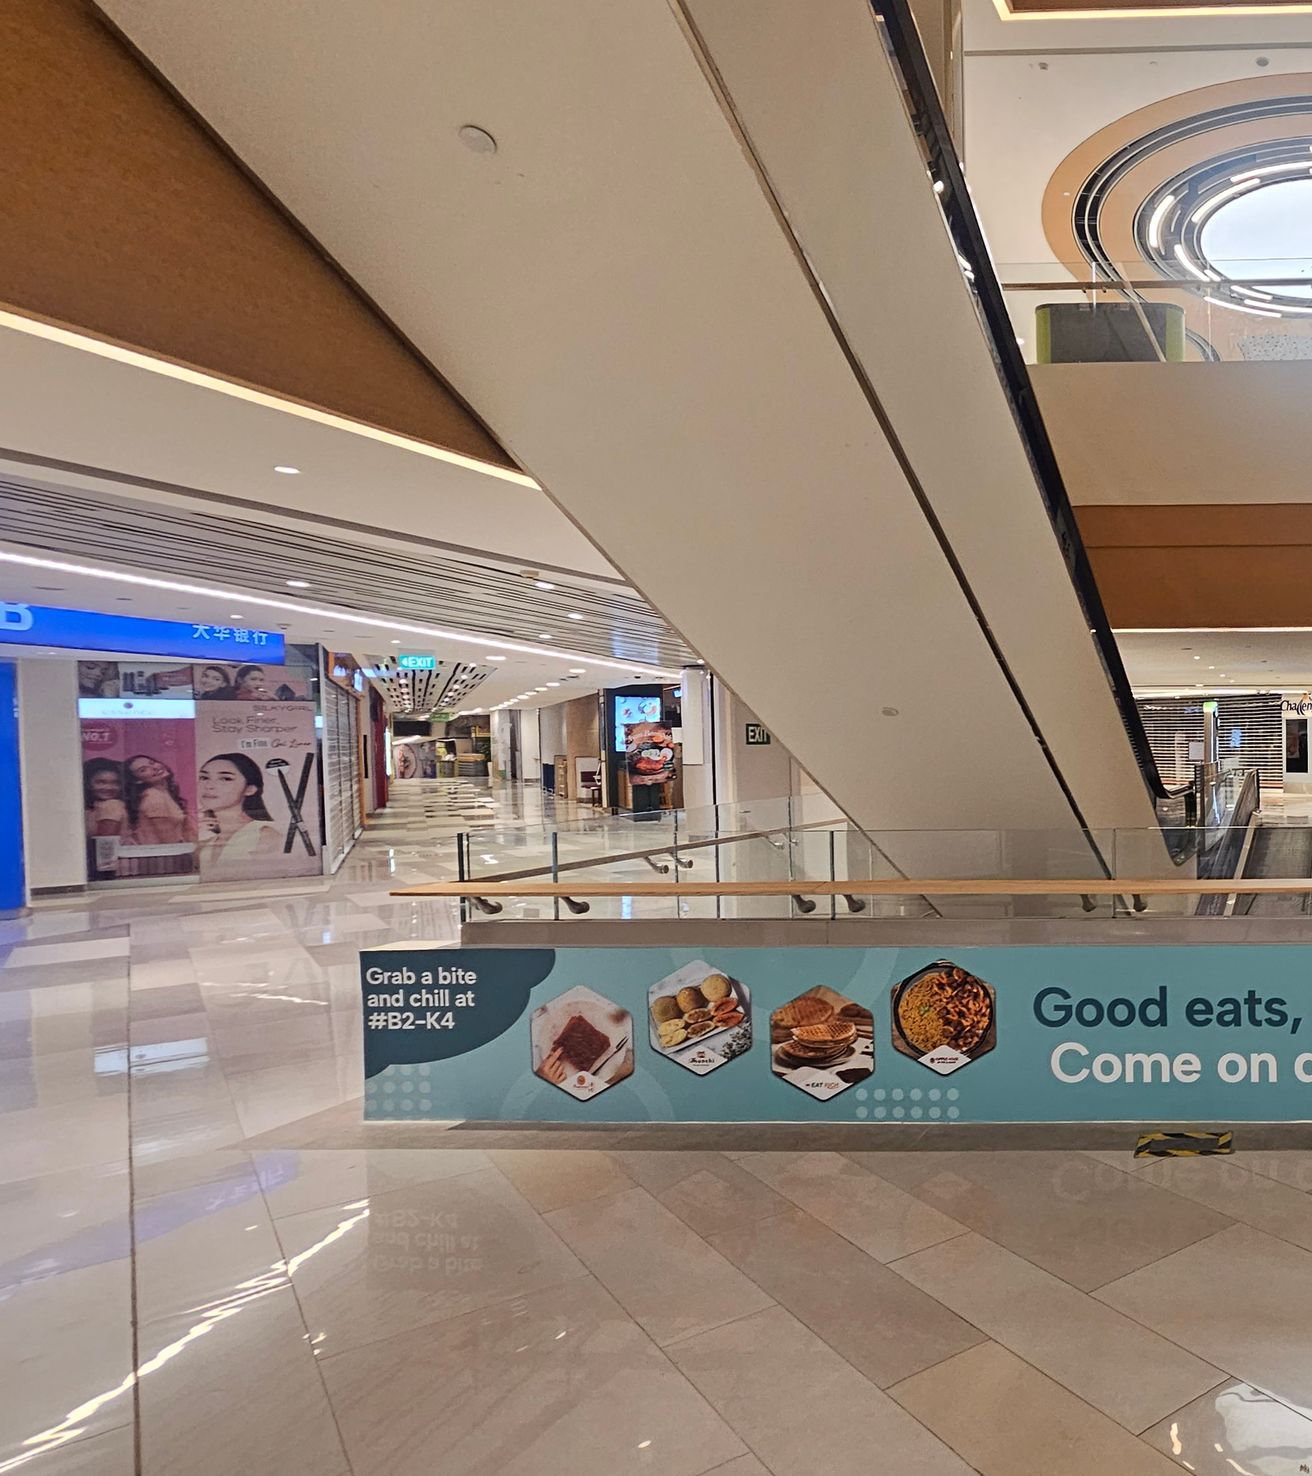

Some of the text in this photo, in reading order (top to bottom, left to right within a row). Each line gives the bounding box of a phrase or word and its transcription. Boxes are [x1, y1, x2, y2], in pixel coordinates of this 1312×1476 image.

[409, 656, 433, 668] EXIT
[366, 967, 477, 985] Grab a bite
[367, 989, 476, 1007] and chill at
[1033, 986, 1168, 1028] Good
[1185, 989, 1304, 1035] eats,
[1051, 1042, 1202, 1083] Come
[1218, 1053, 1278, 1083] on
